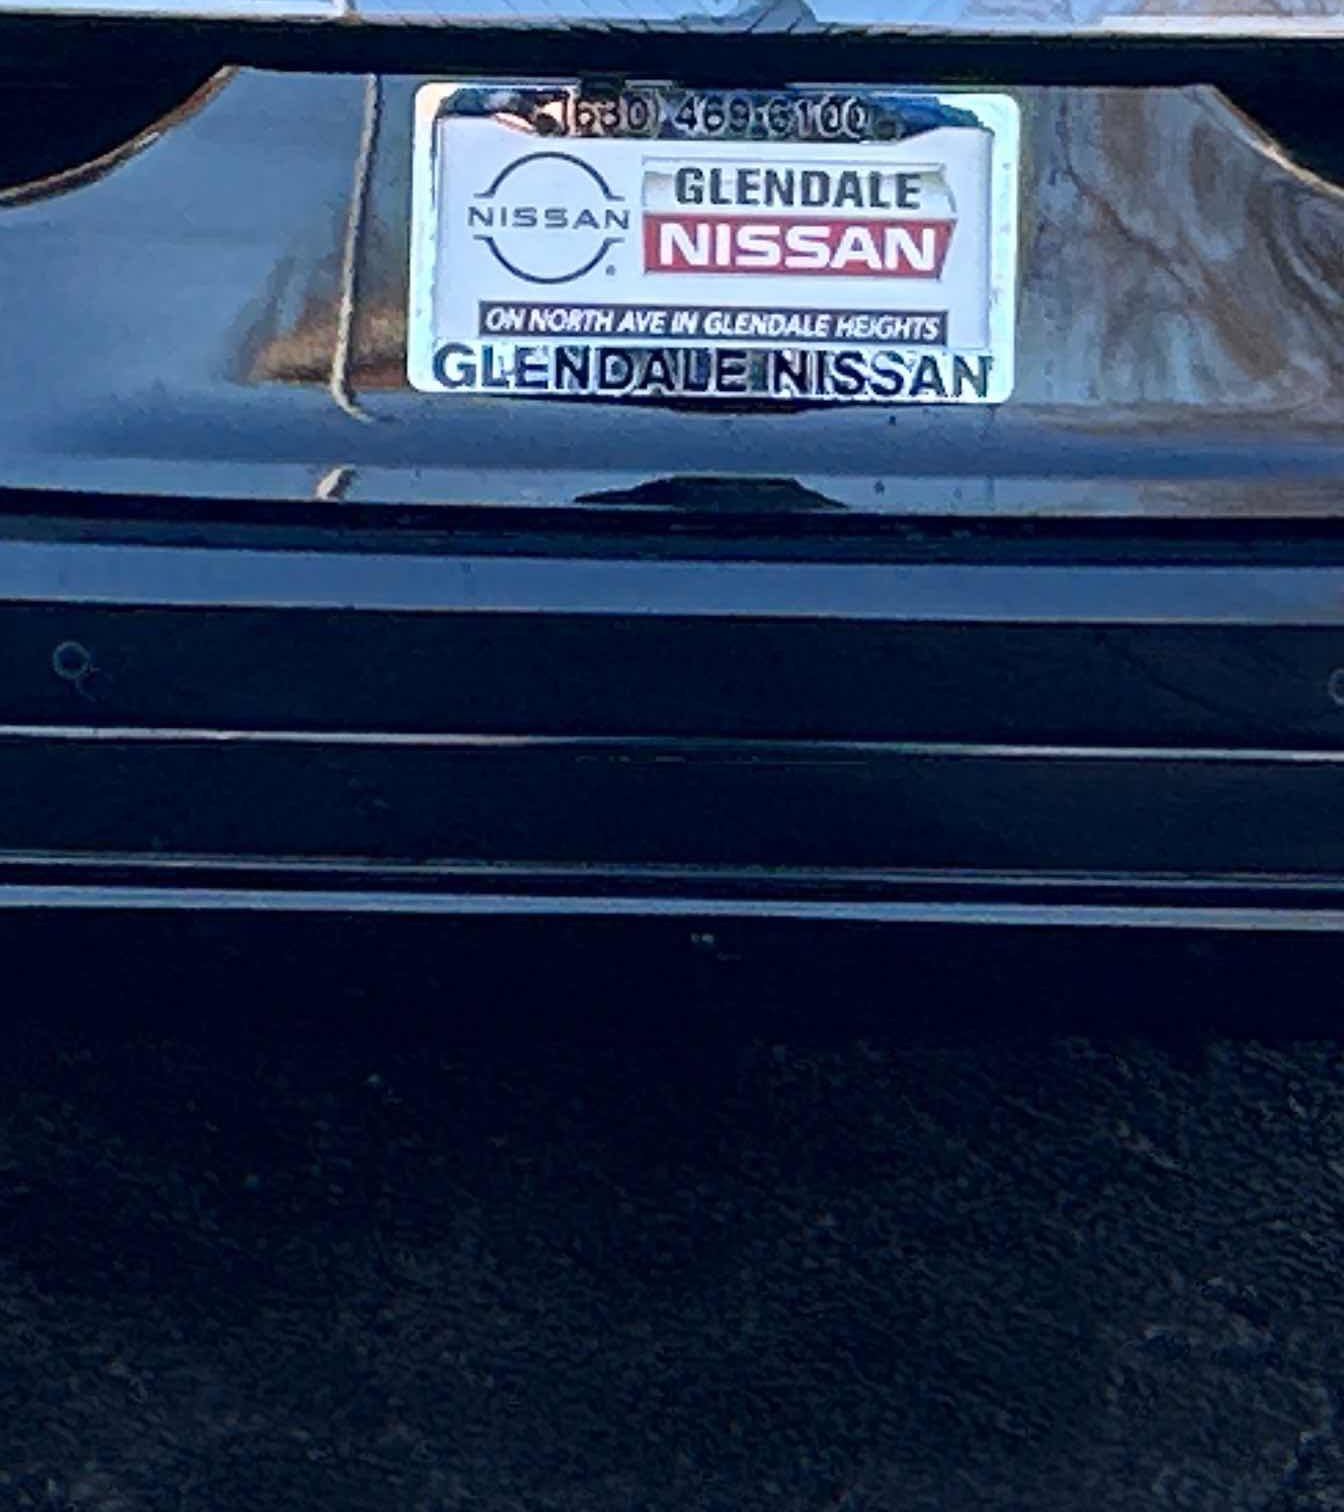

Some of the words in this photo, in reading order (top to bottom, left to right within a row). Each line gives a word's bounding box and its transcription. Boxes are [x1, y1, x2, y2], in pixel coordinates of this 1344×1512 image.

[675, 167, 921, 209] GLENDALE
[467, 206, 630, 229] NISSAN
[659, 223, 936, 271] NISSAN
[485, 307, 525, 332] ON
[527, 308, 613, 333] NORTH
[617, 311, 666, 334] AVE
[671, 312, 698, 335] IN
[704, 311, 828, 337] GLENDALE
[835, 313, 940, 340] HEIGHTS
[432, 341, 749, 392] GLENDALE
[773, 348, 994, 398] NISSAN
